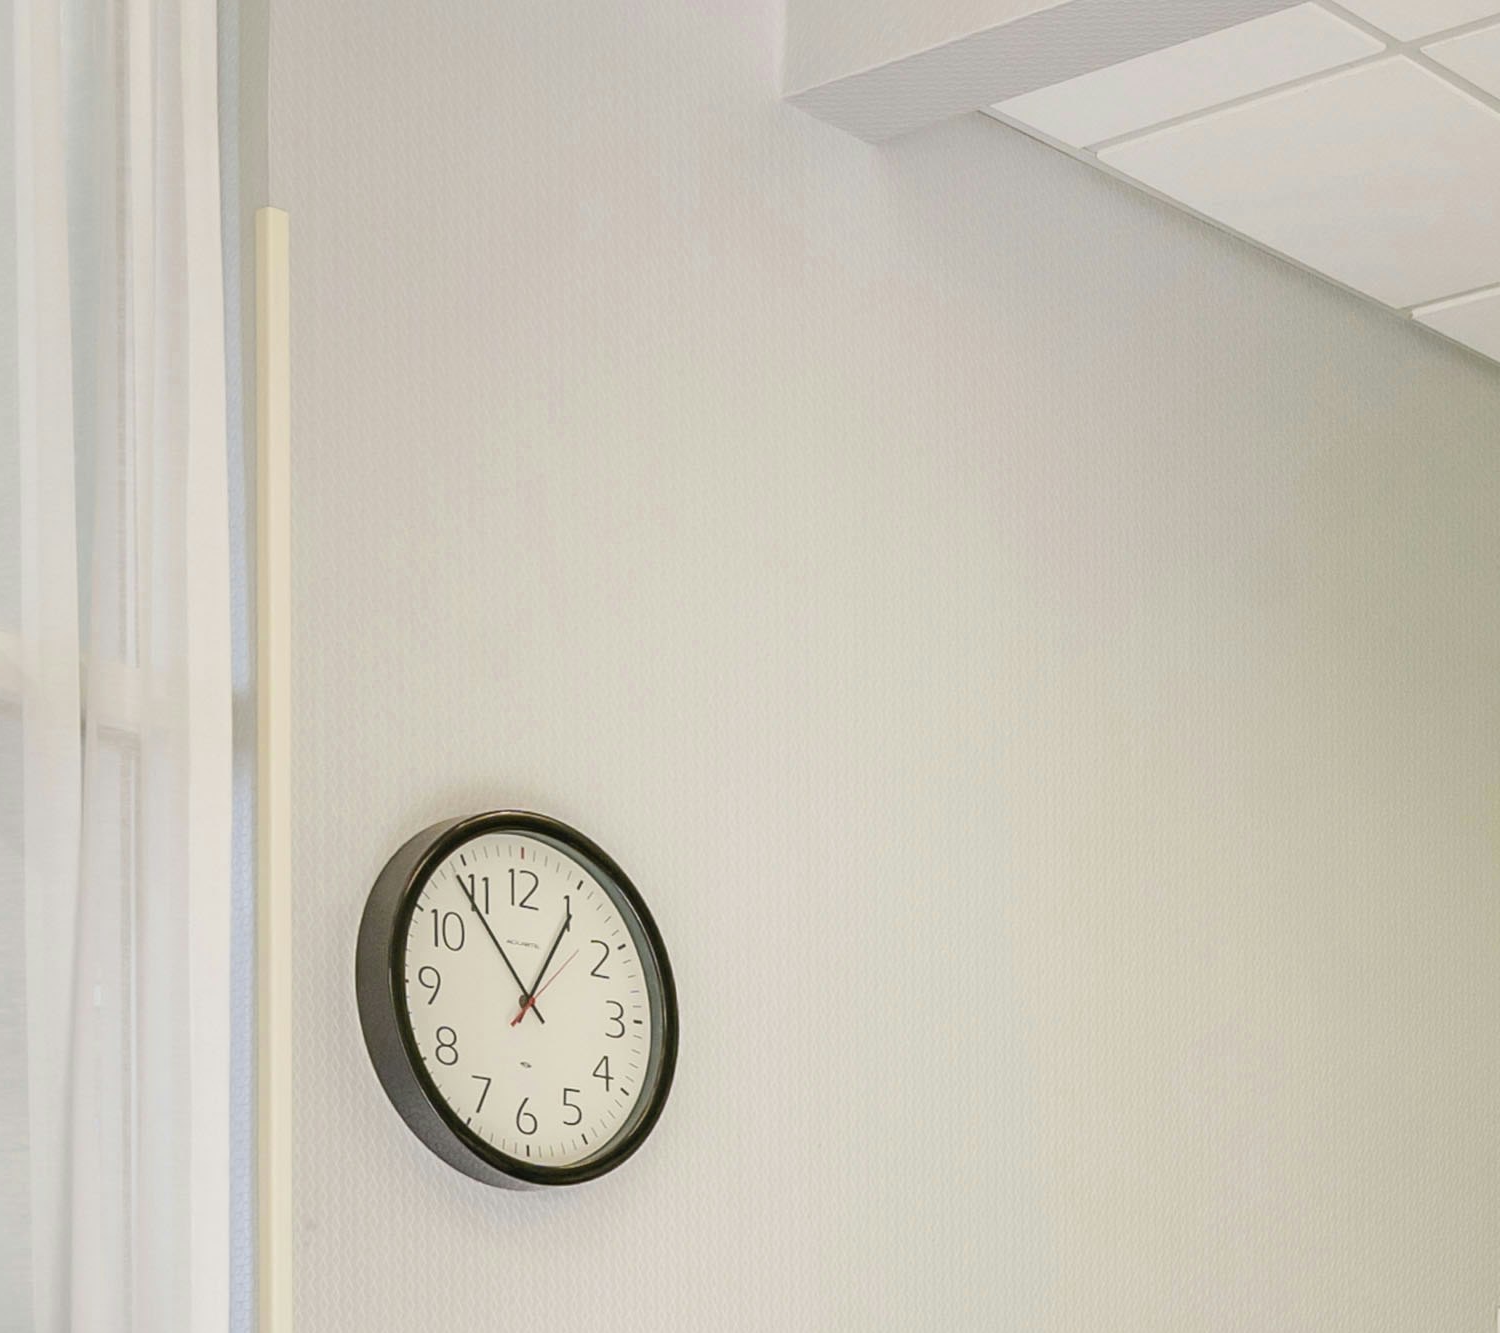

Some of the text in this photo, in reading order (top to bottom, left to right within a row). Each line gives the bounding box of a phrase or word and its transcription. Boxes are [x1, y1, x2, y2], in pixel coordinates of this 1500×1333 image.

[468, 873, 490, 915] 11
[508, 868, 540, 911] 12
[431, 908, 465, 952] 10
[563, 895, 571, 932] 1
[590, 940, 610, 979] 2
[418, 966, 441, 1005] 9
[605, 1000, 625, 1039] 3
[435, 1026, 459, 1066] 8
[592, 1055, 614, 1093] 4
[471, 1075, 492, 1114] 7
[562, 1088, 583, 1126] 5
[515, 1097, 538, 1135] 6
